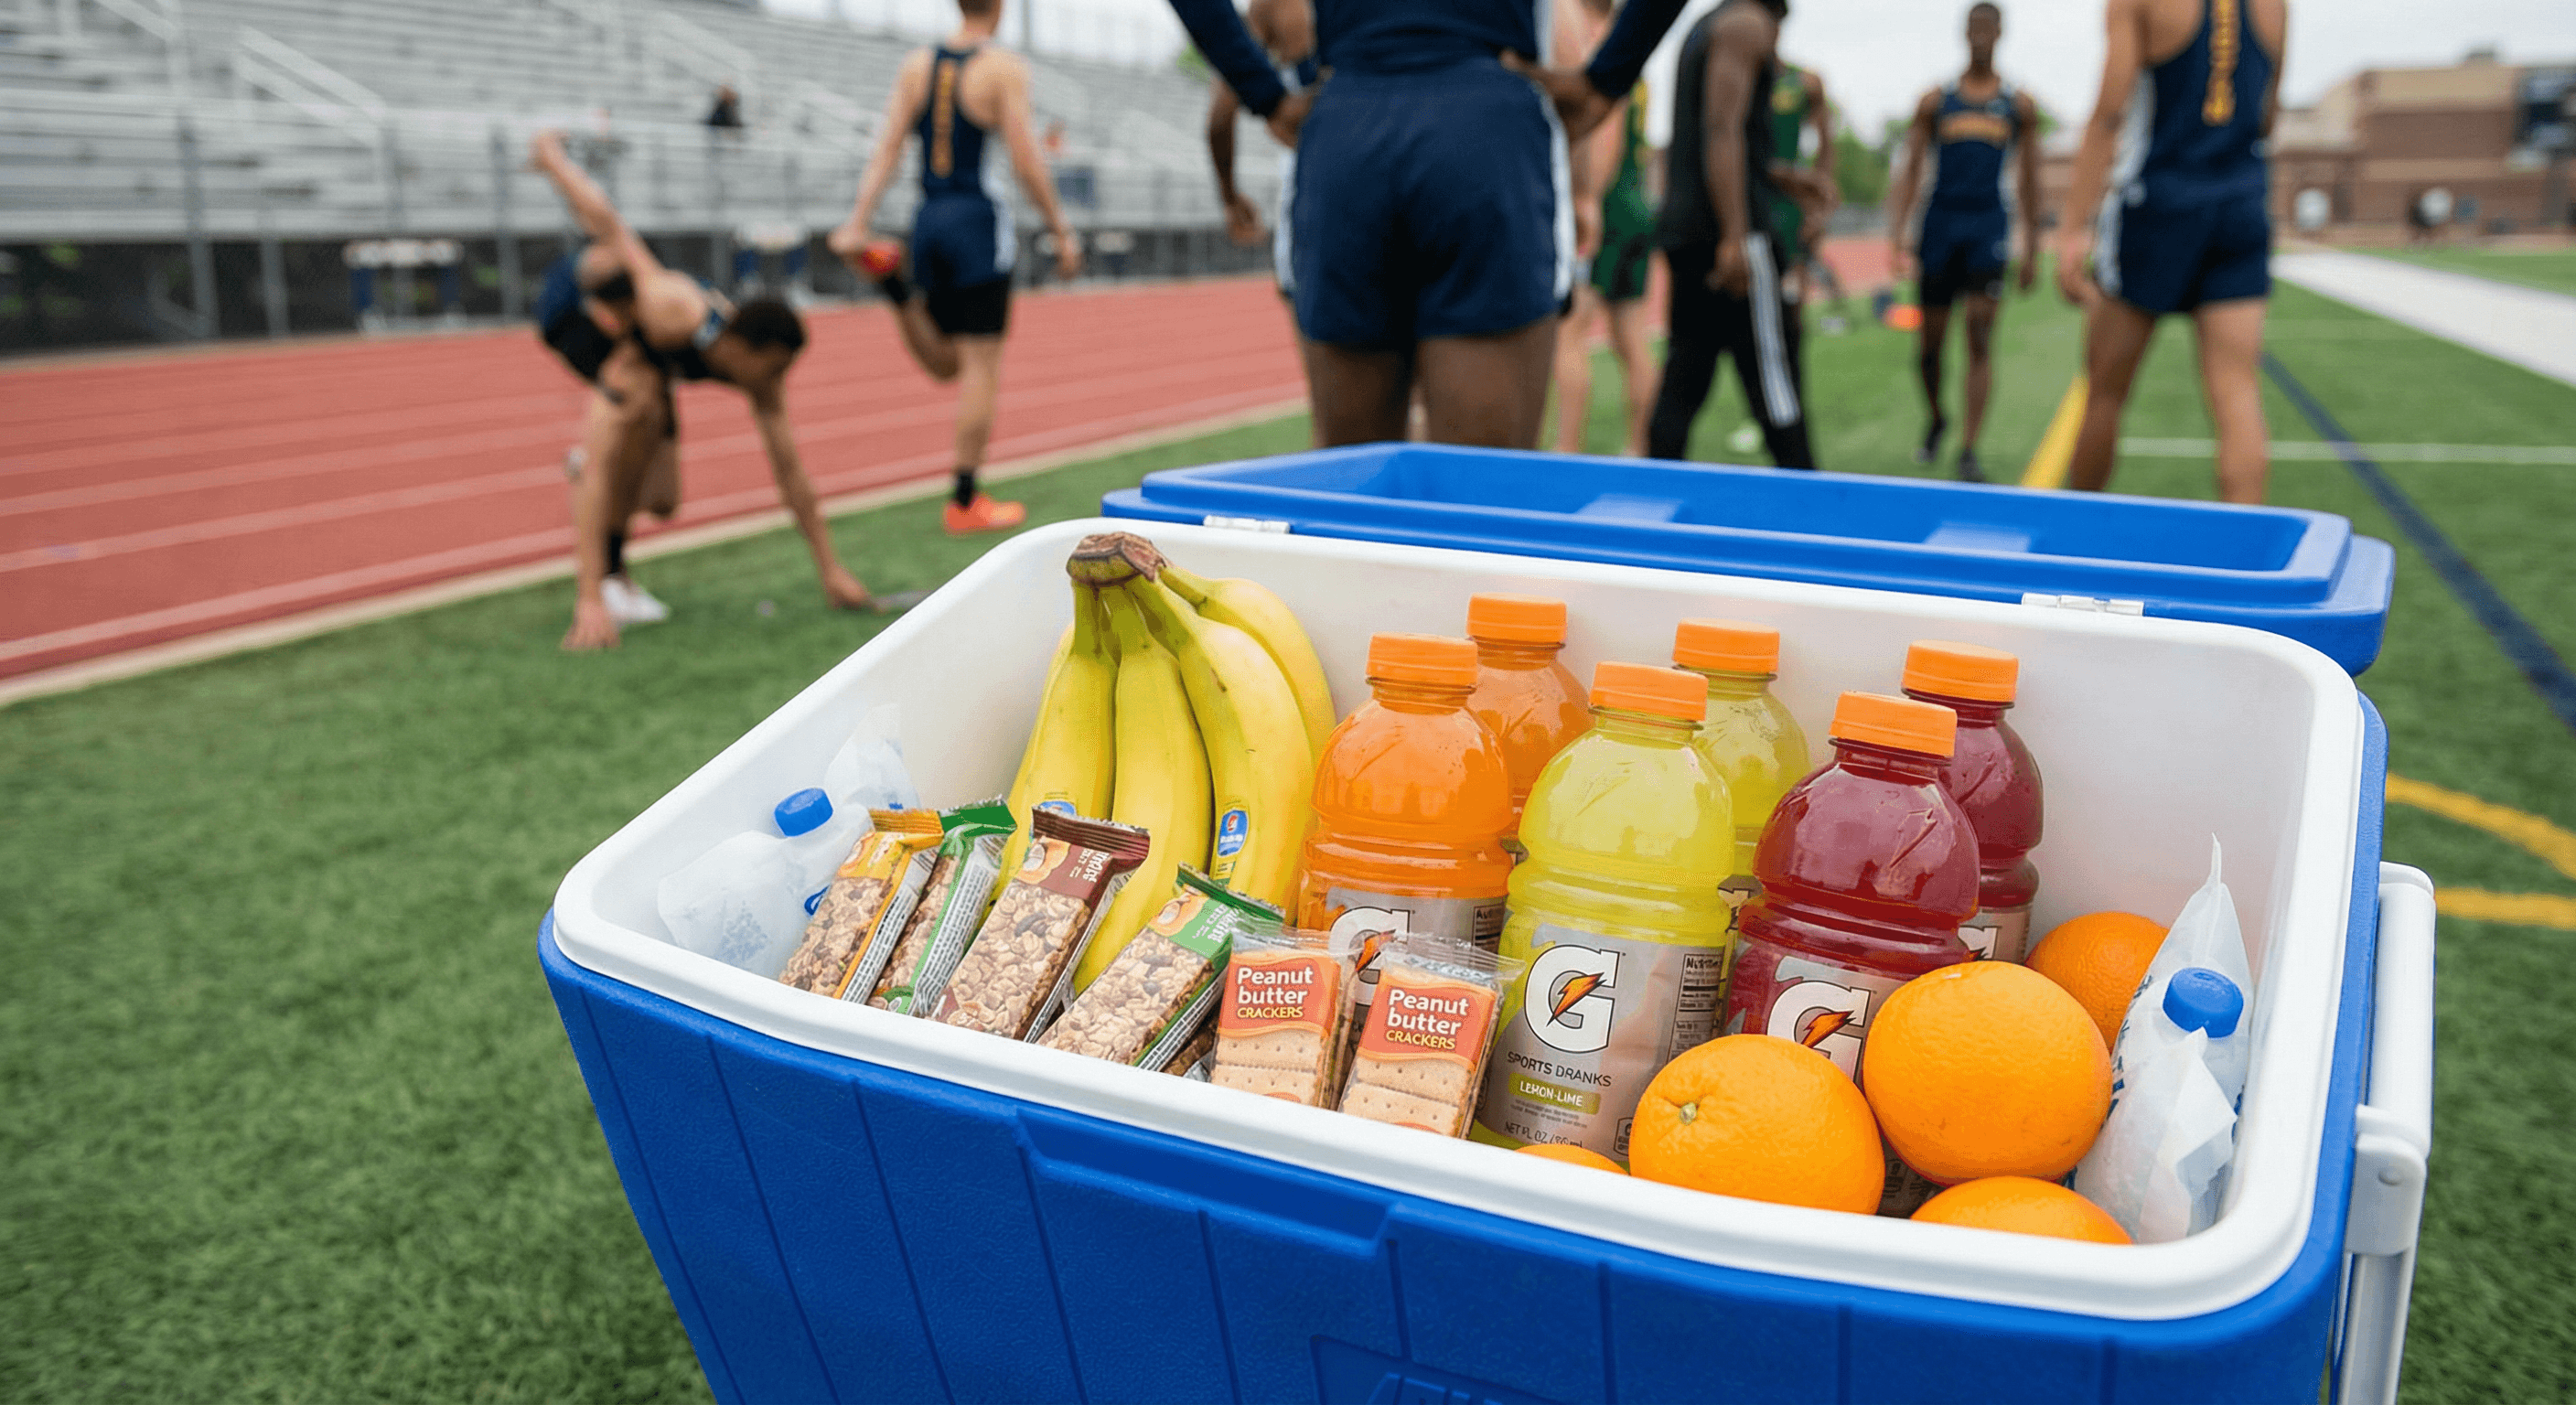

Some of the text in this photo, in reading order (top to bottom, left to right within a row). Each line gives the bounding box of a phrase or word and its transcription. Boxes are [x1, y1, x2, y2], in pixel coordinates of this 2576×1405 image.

[1237, 966, 1314, 985] Peanut
[1238, 986, 1308, 1004] butter
[1389, 989, 1469, 1016] Peanut
[1524, 944, 1620, 1054] G
[1237, 1006, 1304, 1019] CRACKERS
[1387, 1006, 1462, 1035] butter
[1385, 1029, 1456, 1050] CRACKERS
[1507, 1051, 1612, 1087] SPORTS DRANKS
